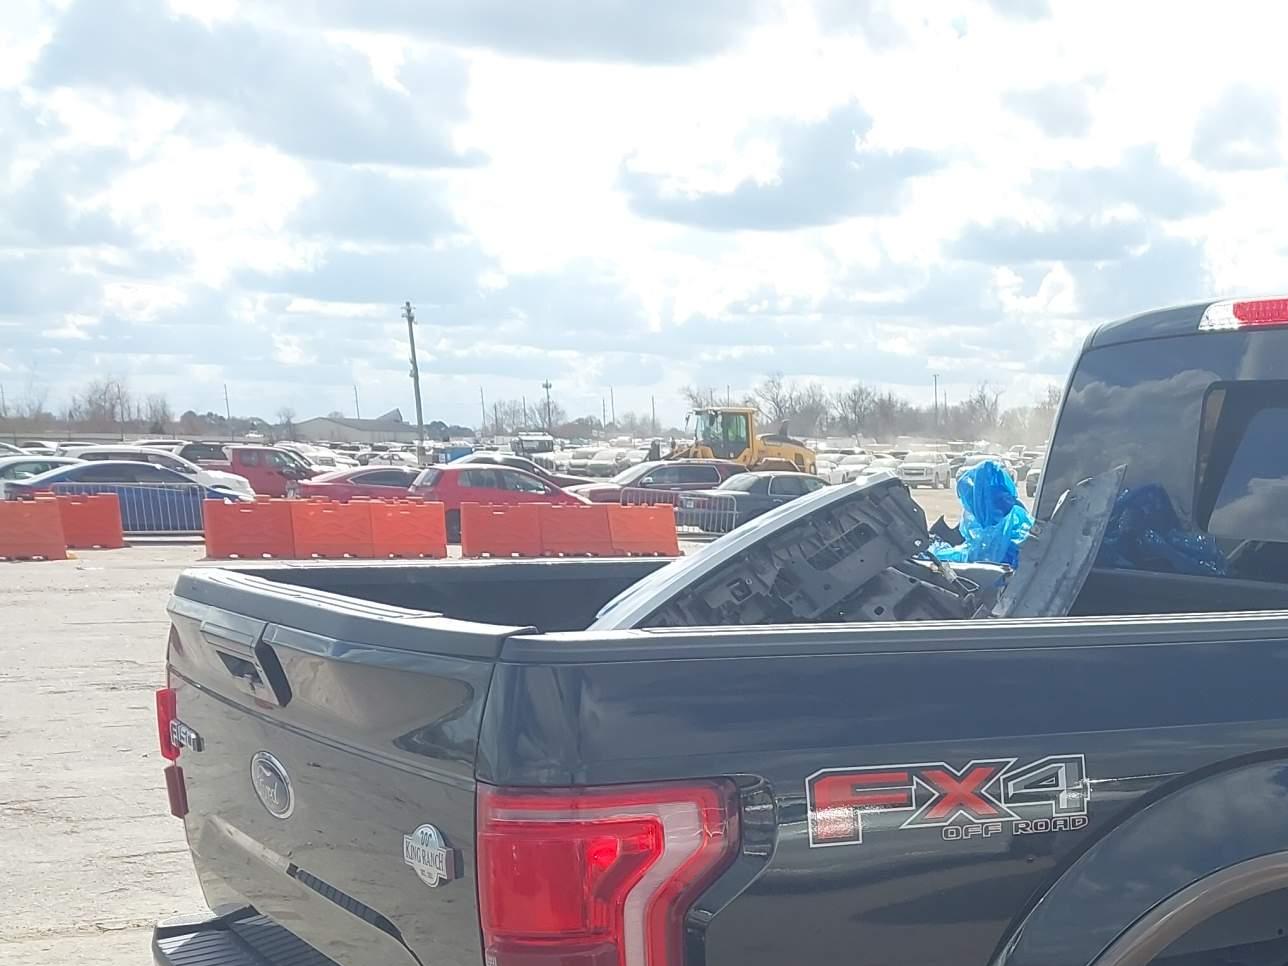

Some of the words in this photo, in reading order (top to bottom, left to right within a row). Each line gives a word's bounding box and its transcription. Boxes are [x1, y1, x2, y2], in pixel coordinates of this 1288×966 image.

[805, 753, 1091, 847] FX4
[942, 822, 1002, 841] OFF
[1012, 815, 1089, 835] ROAD
[405, 840, 422, 863] KING
[422, 849, 445, 872] RANCH
